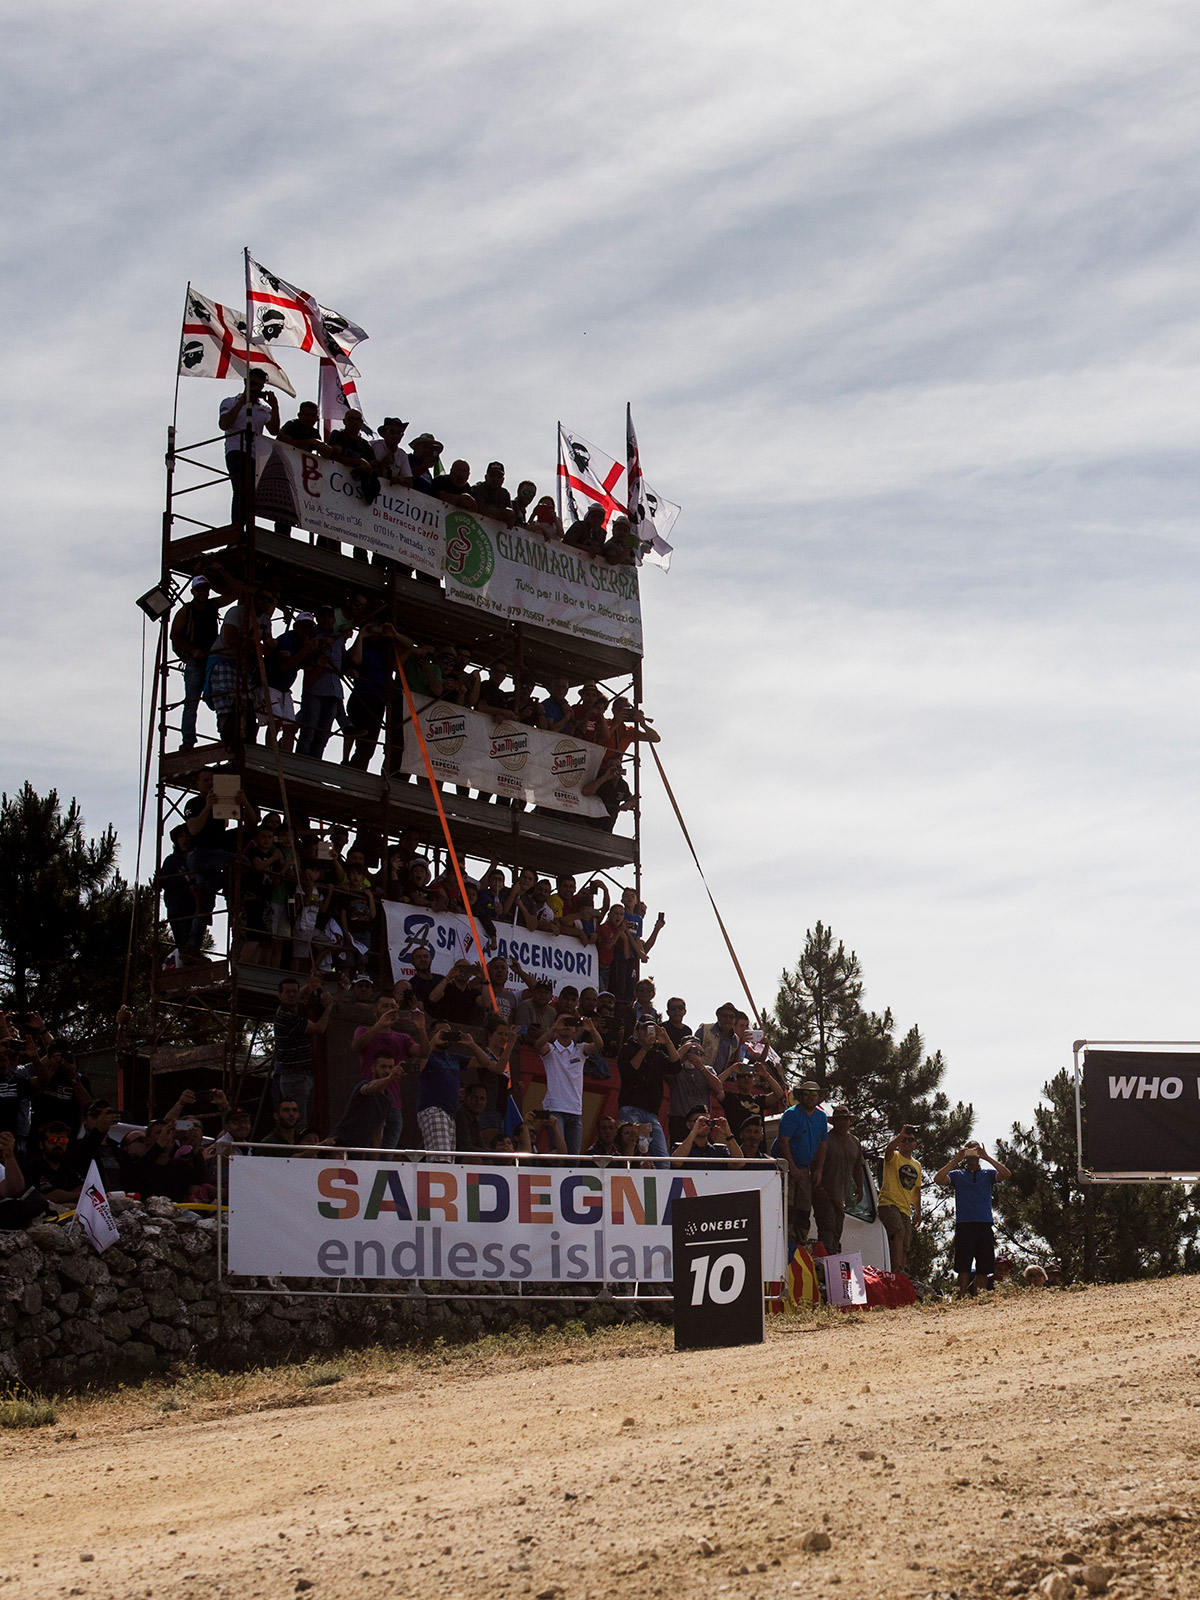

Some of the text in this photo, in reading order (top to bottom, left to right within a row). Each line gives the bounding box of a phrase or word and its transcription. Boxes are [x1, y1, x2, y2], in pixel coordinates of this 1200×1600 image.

[303, 499, 315, 513] Via
[329, 472, 440, 529] Cosruzioni
[372, 507, 440, 541] Di Barracca Carlo
[373, 523, 395, 539] 07016
[515, 578, 535, 596] Tutto
[537, 587, 553, 600] per
[563, 593, 578, 608] Bar
[587, 600, 596, 612] la
[598, 603, 641, 625] Ristorazion
[431, 760, 460, 772] ESPECIAL
[497, 775, 523, 788] ESPECIAL
[554, 791, 580, 802] ESPECIAL
[498, 938, 593, 978] ASCENSORI
[1108, 1075, 1183, 1100] WHO
[317, 1166, 699, 1225] SARDEGNA
[700, 1218, 748, 1233] ONEBET
[317, 1226, 673, 1280] endless islan
[689, 1253, 747, 1307] 10
